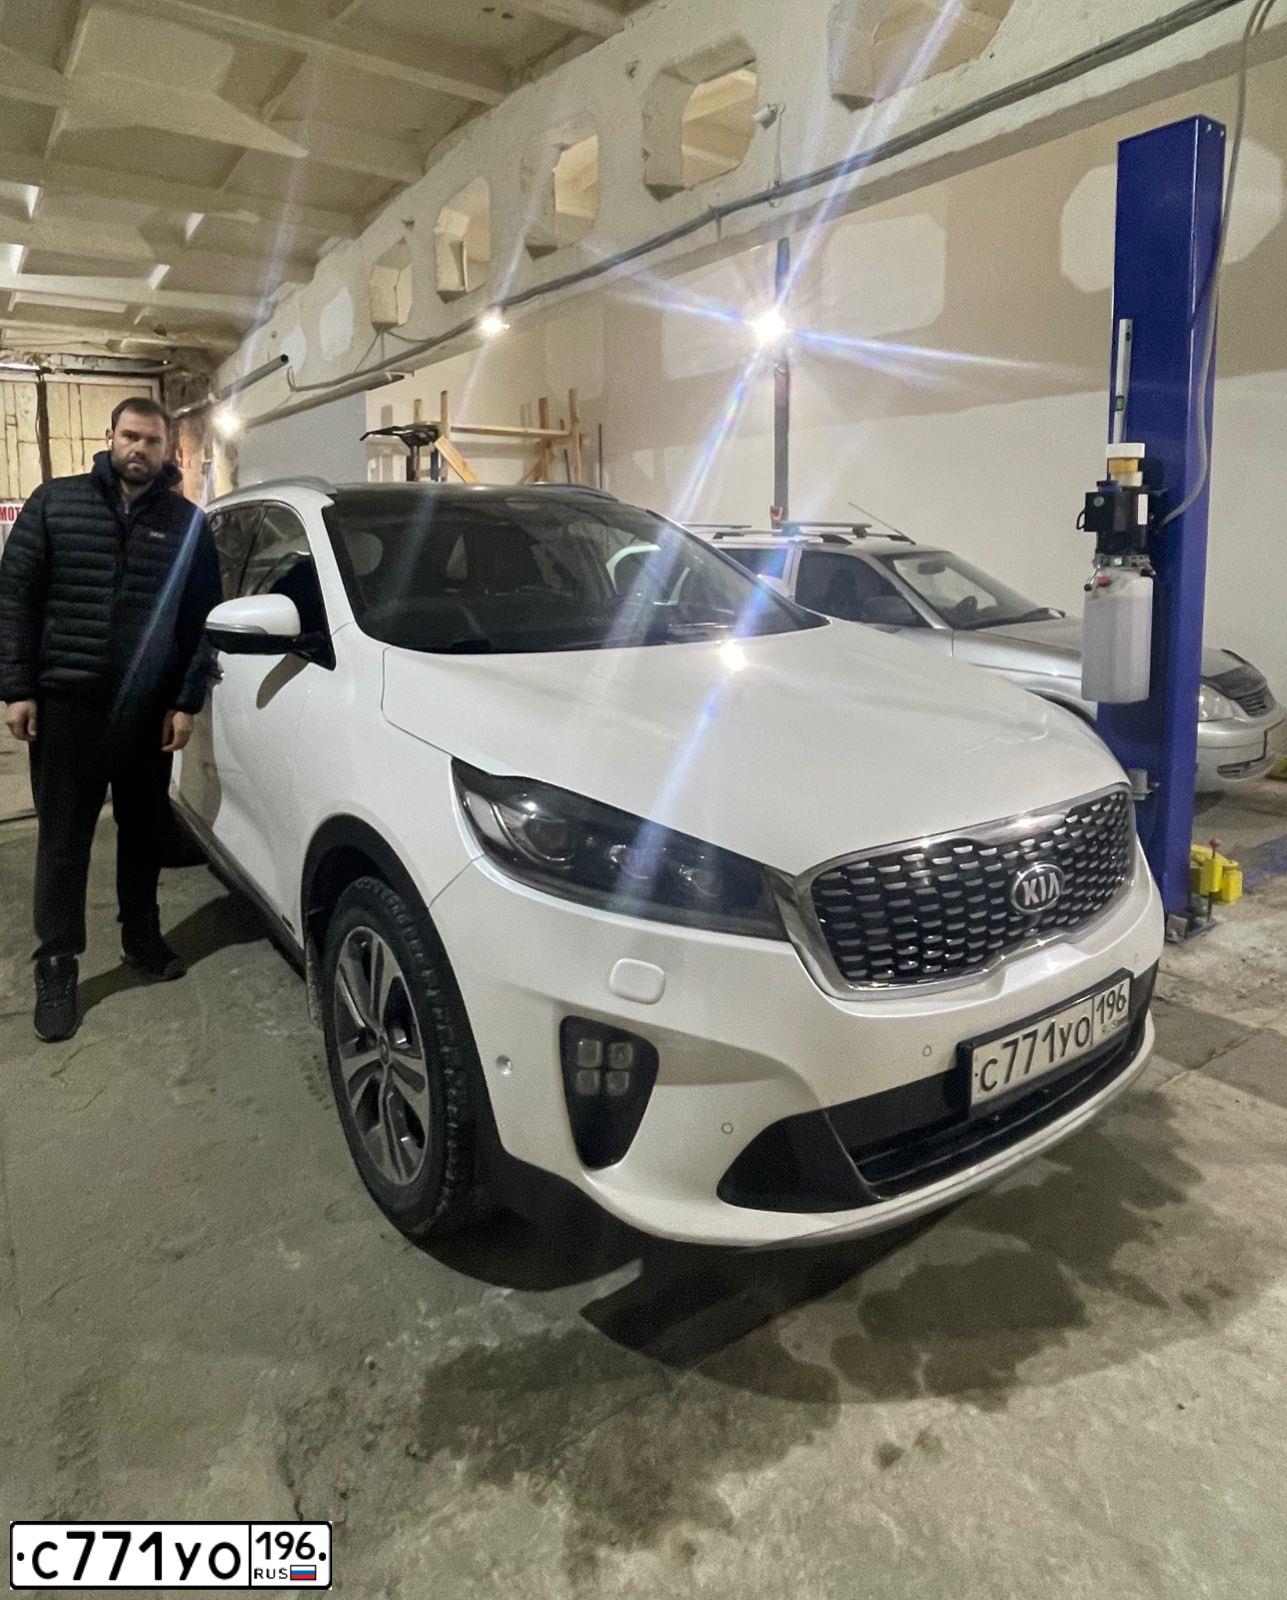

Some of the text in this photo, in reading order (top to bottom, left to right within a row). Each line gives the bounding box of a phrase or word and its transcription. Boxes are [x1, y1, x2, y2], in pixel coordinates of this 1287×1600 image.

[1022, 872, 1060, 906] KIA
[980, 983, 1127, 1091] С771УО 196
